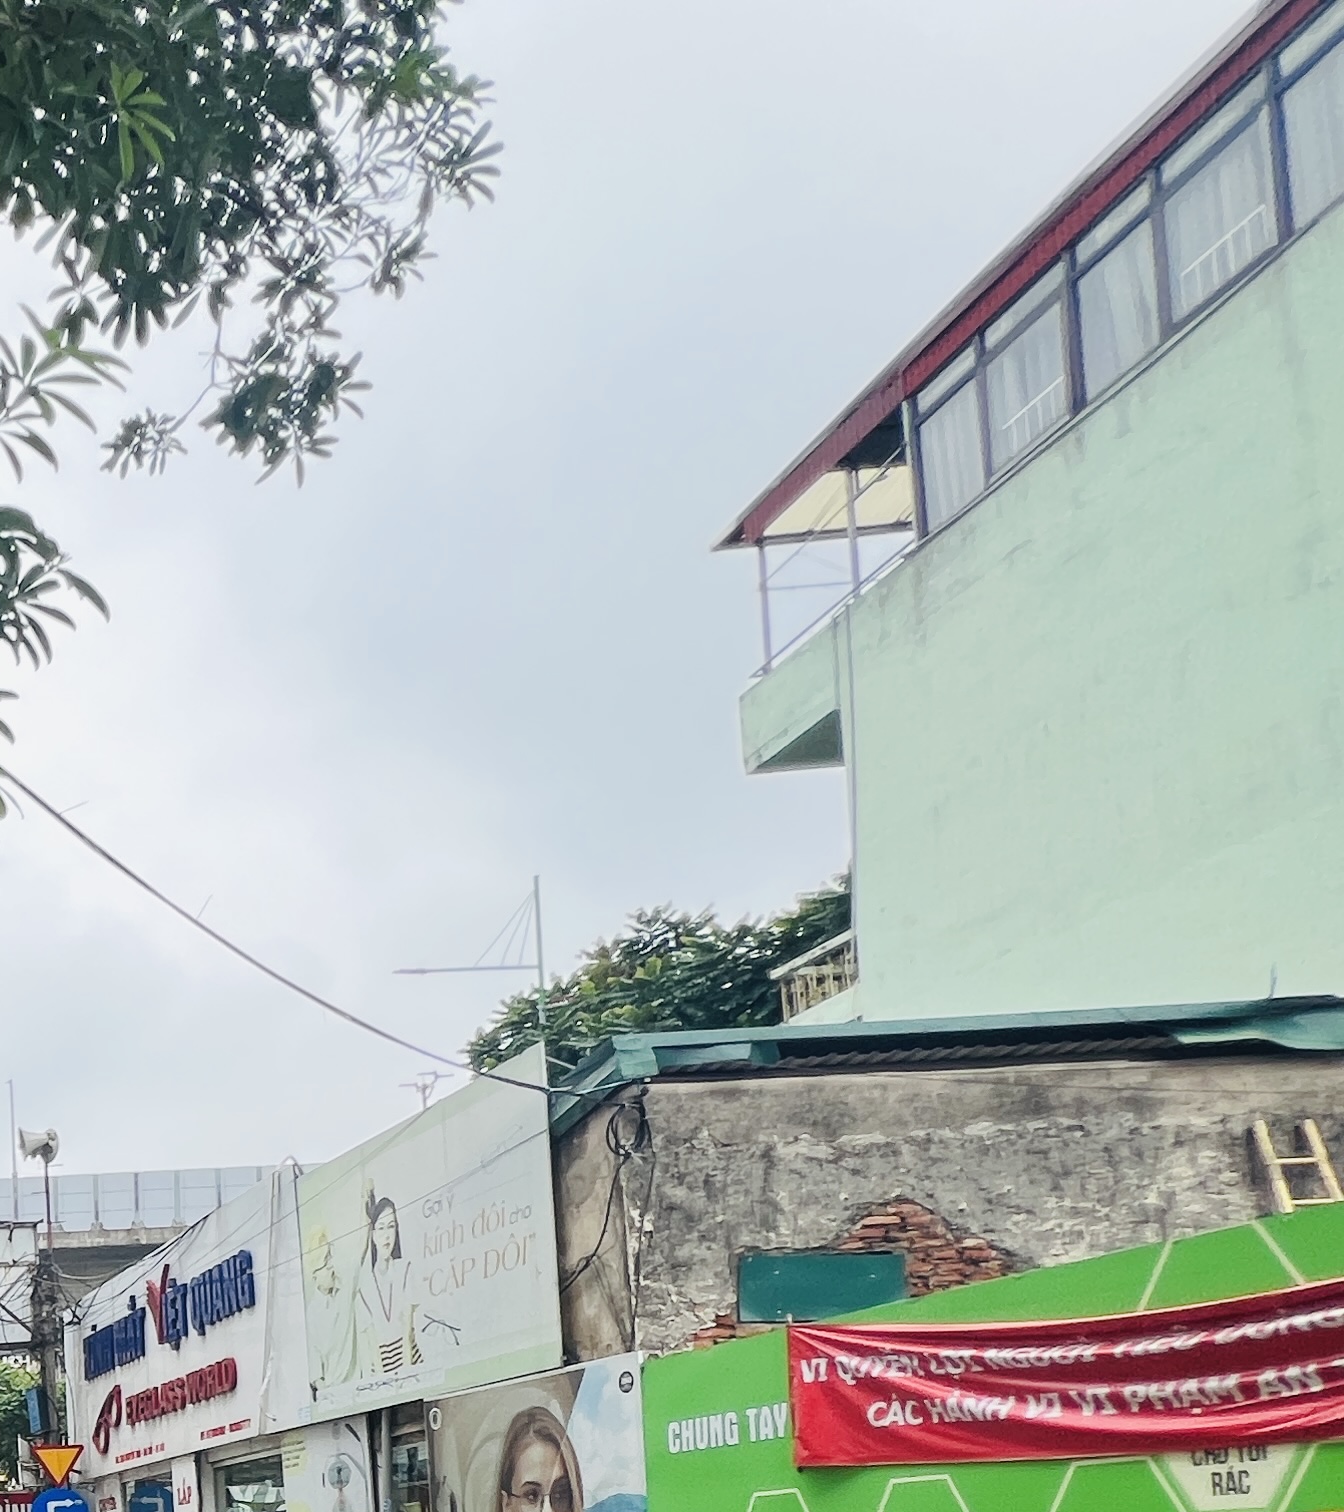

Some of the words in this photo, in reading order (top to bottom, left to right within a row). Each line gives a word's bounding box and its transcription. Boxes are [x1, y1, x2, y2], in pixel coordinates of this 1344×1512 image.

[424, 1219, 464, 1259] kính
[190, 1250, 256, 1336] QUANG
[186, 1357, 238, 1405] WORLD
[867, 1393, 924, 1428] CÁC
[1123, 1373, 1244, 1415] PHẠM
[1257, 1364, 1324, 1399] AN
[668, 1411, 740, 1454] CHUNG
[745, 1402, 788, 1443] TAY
[1211, 1465, 1251, 1496] RÁC
